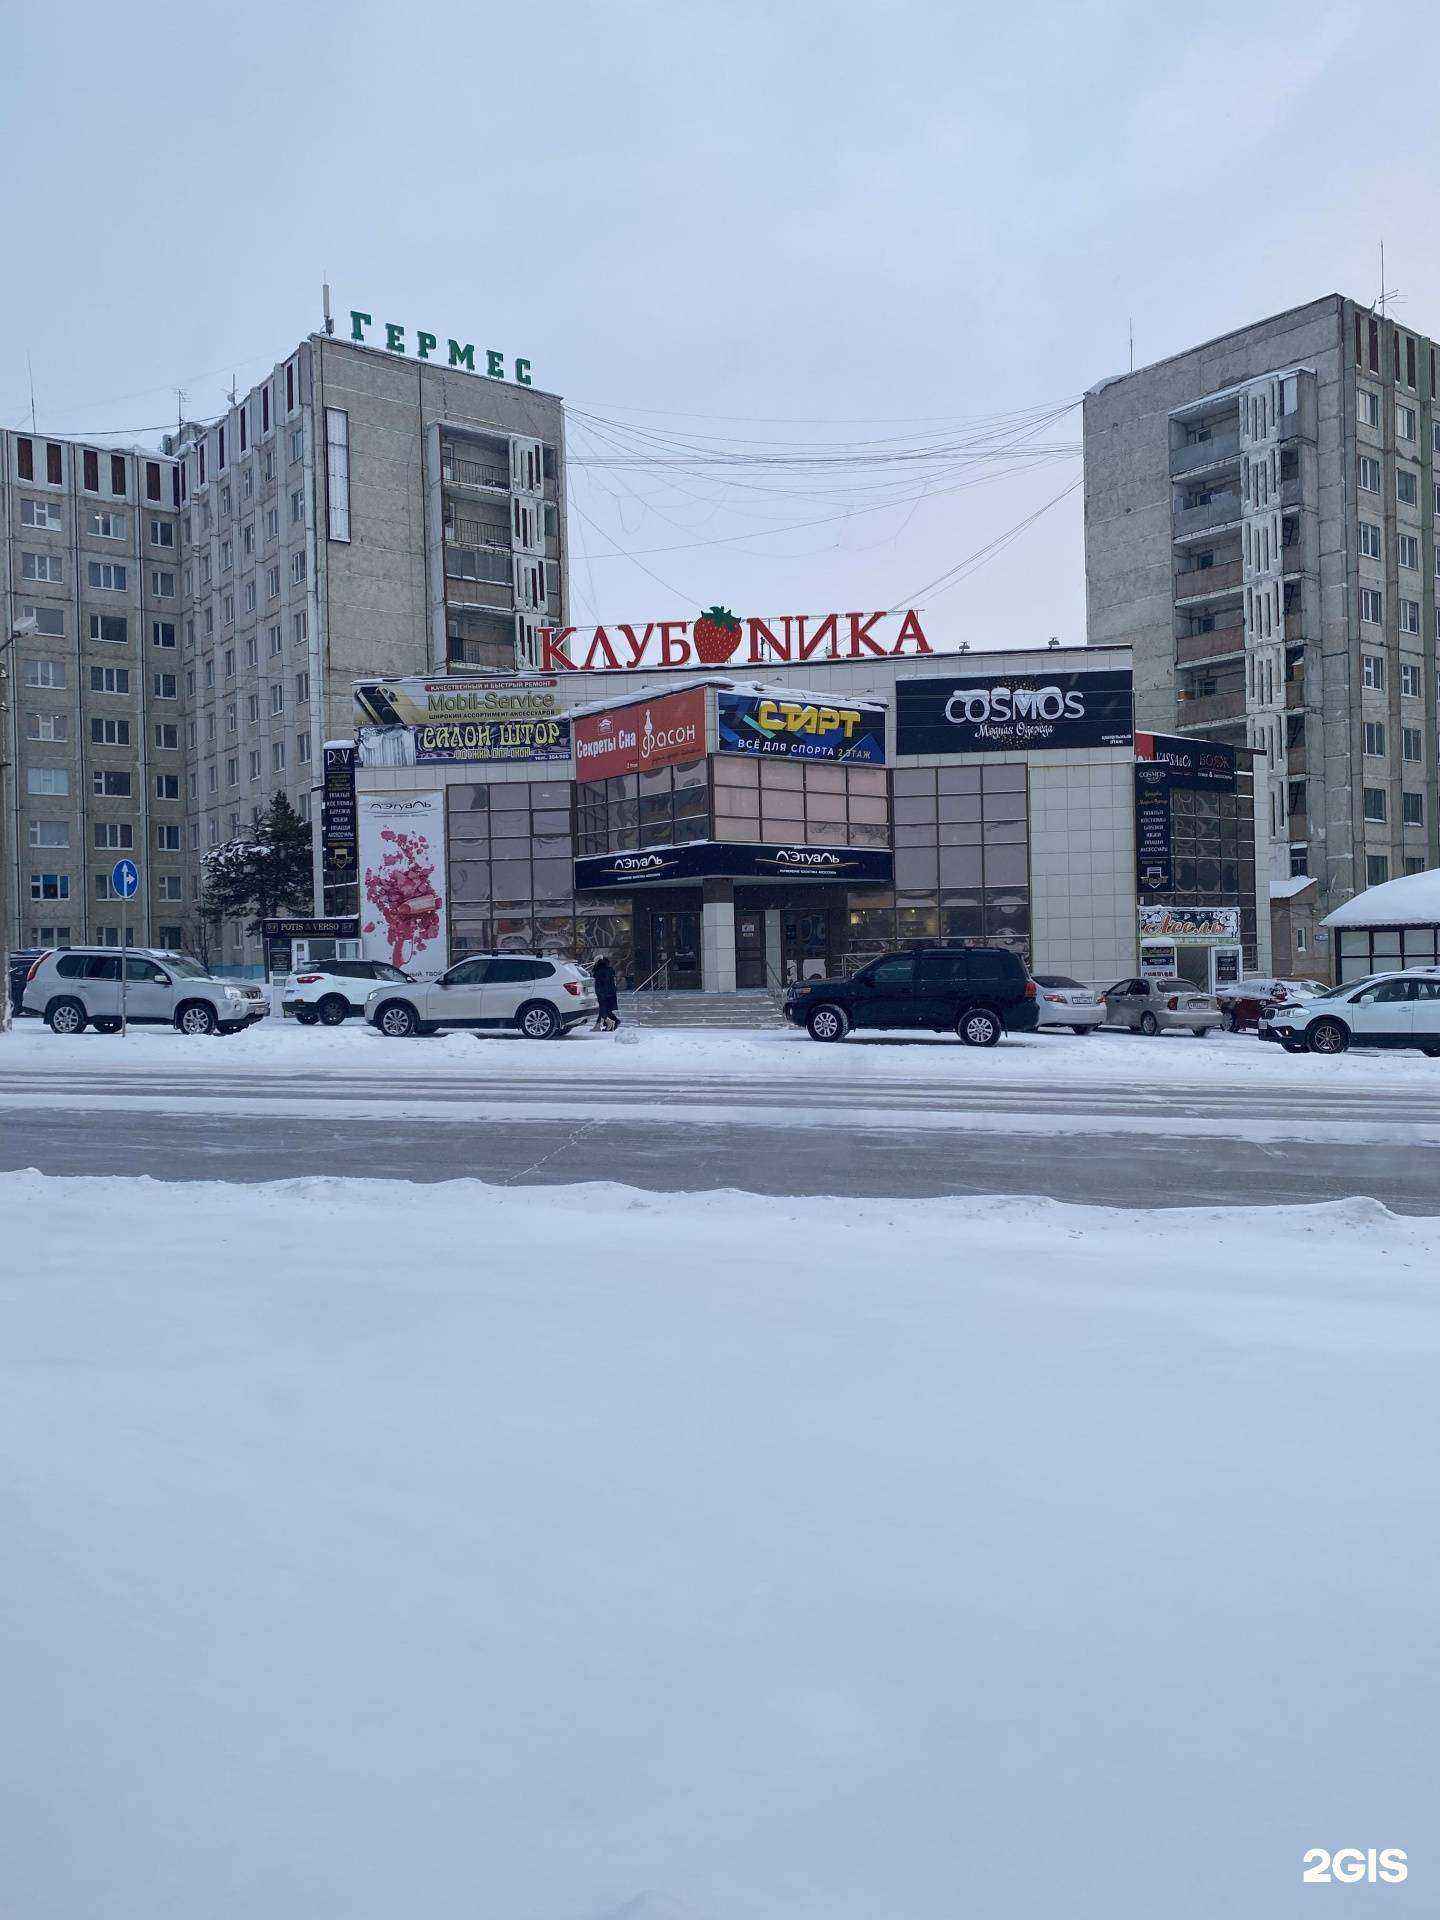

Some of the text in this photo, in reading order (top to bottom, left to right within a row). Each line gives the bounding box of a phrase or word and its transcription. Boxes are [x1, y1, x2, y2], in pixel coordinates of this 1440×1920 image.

[350, 310, 532, 385] ГЕРМЕС
[524, 680, 551, 688] РЕМОНТ
[428, 690, 555, 712] Mobil-Service
[945, 687, 1085, 724] COSMOS
[758, 700, 861, 738] СТАРТ
[423, 722, 560, 749] САЛОН ШТОР
[577, 729, 637, 759] Секреты Сна
[738, 738, 872, 760] ВСЁ ДЛЯ СПОРТА 2 ЭТАЖ
